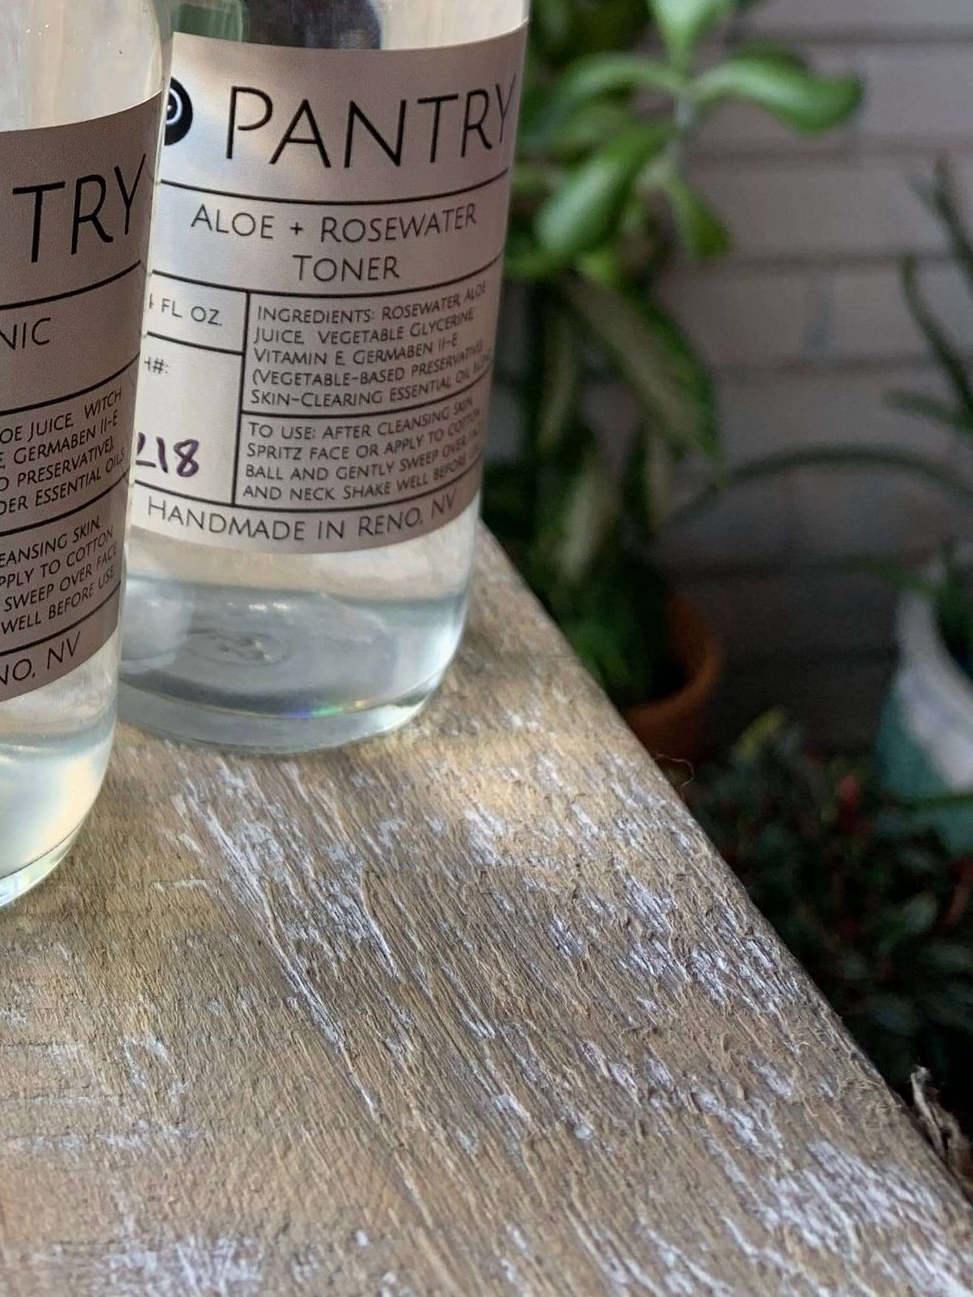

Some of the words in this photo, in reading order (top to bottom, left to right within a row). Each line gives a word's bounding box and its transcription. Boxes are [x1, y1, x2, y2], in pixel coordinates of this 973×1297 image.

[225, 73, 516, 169] PANTRY
[190, 203, 275, 240] ALOE
[290, 222, 303, 236] +
[320, 202, 477, 244] ROSEWATER
[292, 255, 400, 283] TONER
[161, 298, 183, 318] FL
[257, 305, 375, 324] INGREDIENTS:
[317, 326, 403, 345] VEGETABLE
[253, 347, 327, 365] VITAMIN
[353, 342, 433, 364] GERMABEN
[251, 389, 382, 407] SKIN-CLEARING
[389, 378, 452, 402] ESSENTIAL
[253, 367, 405, 386] (VEGETABLE-BASED
[84, 386, 123, 419] WITCH
[248, 421, 273, 438] TO
[281, 426, 316, 440] USE:
[322, 424, 372, 440] AFTER
[377, 407, 449, 436] CLEANSING
[13, 425, 96, 465] GERMABEN
[246, 442, 302, 461] SPRITZ
[309, 446, 350, 460] FACE
[356, 444, 379, 458] OR
[384, 434, 424, 455] APPLY
[428, 428, 443, 442] TO
[245, 463, 283, 480] BALL
[290, 467, 329, 481] AND
[336, 461, 395, 480] GENTLY
[399, 449, 438, 472] SWEEP
[35, 467, 101, 507] ESSENTIAL
[243, 484, 282, 500] AND
[343, 480, 391, 500] SHAKE
[396, 472, 428, 491] WELL
[147, 495, 305, 541] HANDMADE
[318, 519, 344, 540] IN
[430, 488, 457, 519] NV
[40, 559, 61, 578] TO
[66, 525, 114, 567] COTTON
[3, 583, 54, 613] SWEEP
[59, 563, 92, 592] OVER
[0, 611, 42, 635] WELL
[48, 582, 95, 620] BEFORE
[46, 630, 82, 671] NV
